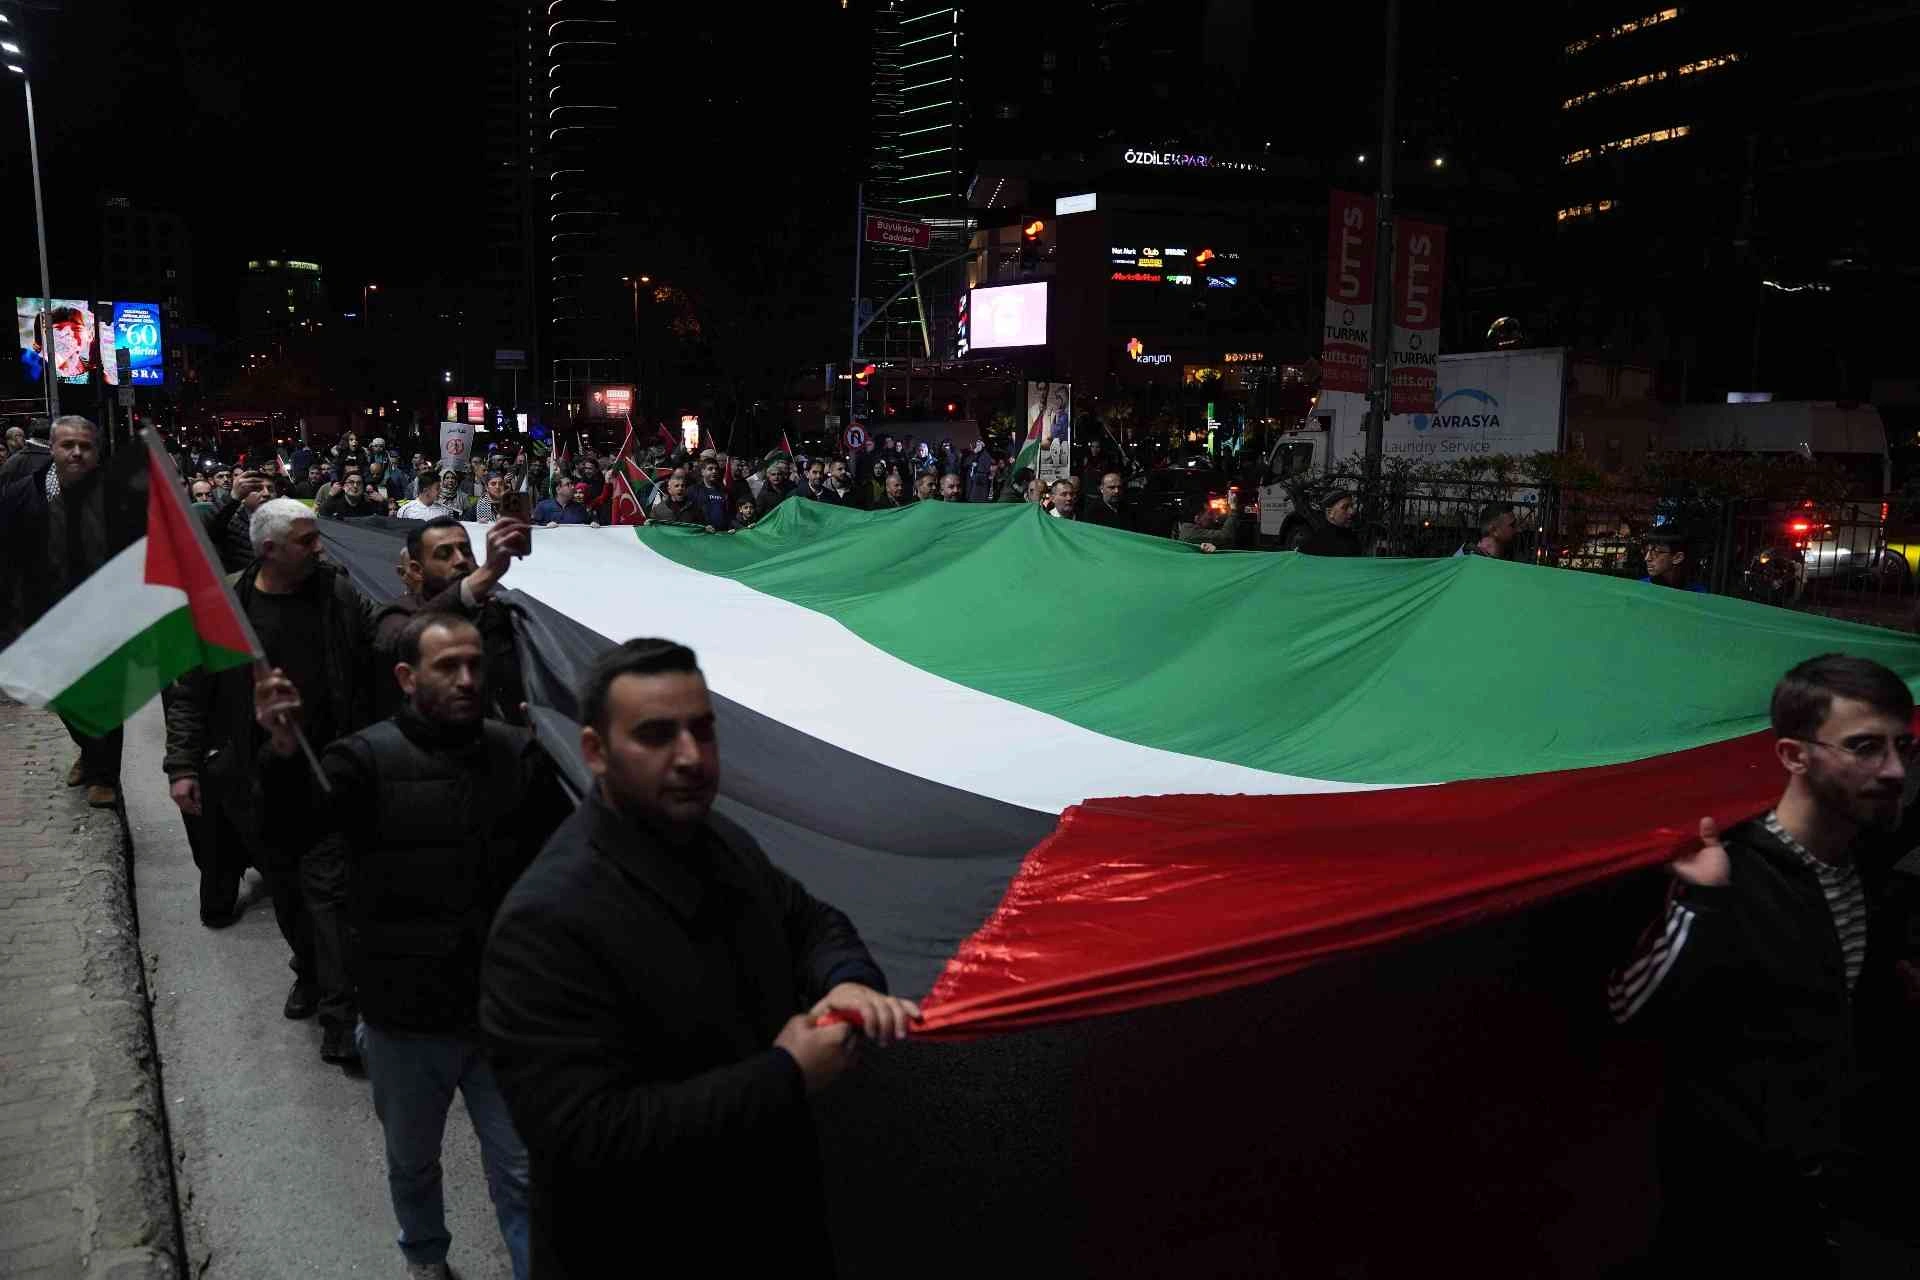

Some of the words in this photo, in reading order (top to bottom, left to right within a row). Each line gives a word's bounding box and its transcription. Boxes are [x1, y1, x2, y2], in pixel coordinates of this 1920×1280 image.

[1341, 207, 1362, 298] UTTS
[1407, 232, 1431, 323] UTTS
[1326, 327, 1368, 343] TURPAK
[1393, 352, 1437, 366] TURPAK
[131, 369, 159, 379] SRA
[1431, 415, 1500, 428] AVRASYA
[1385, 440, 1437, 456] Laundry
[1440, 440, 1490, 453] Service
